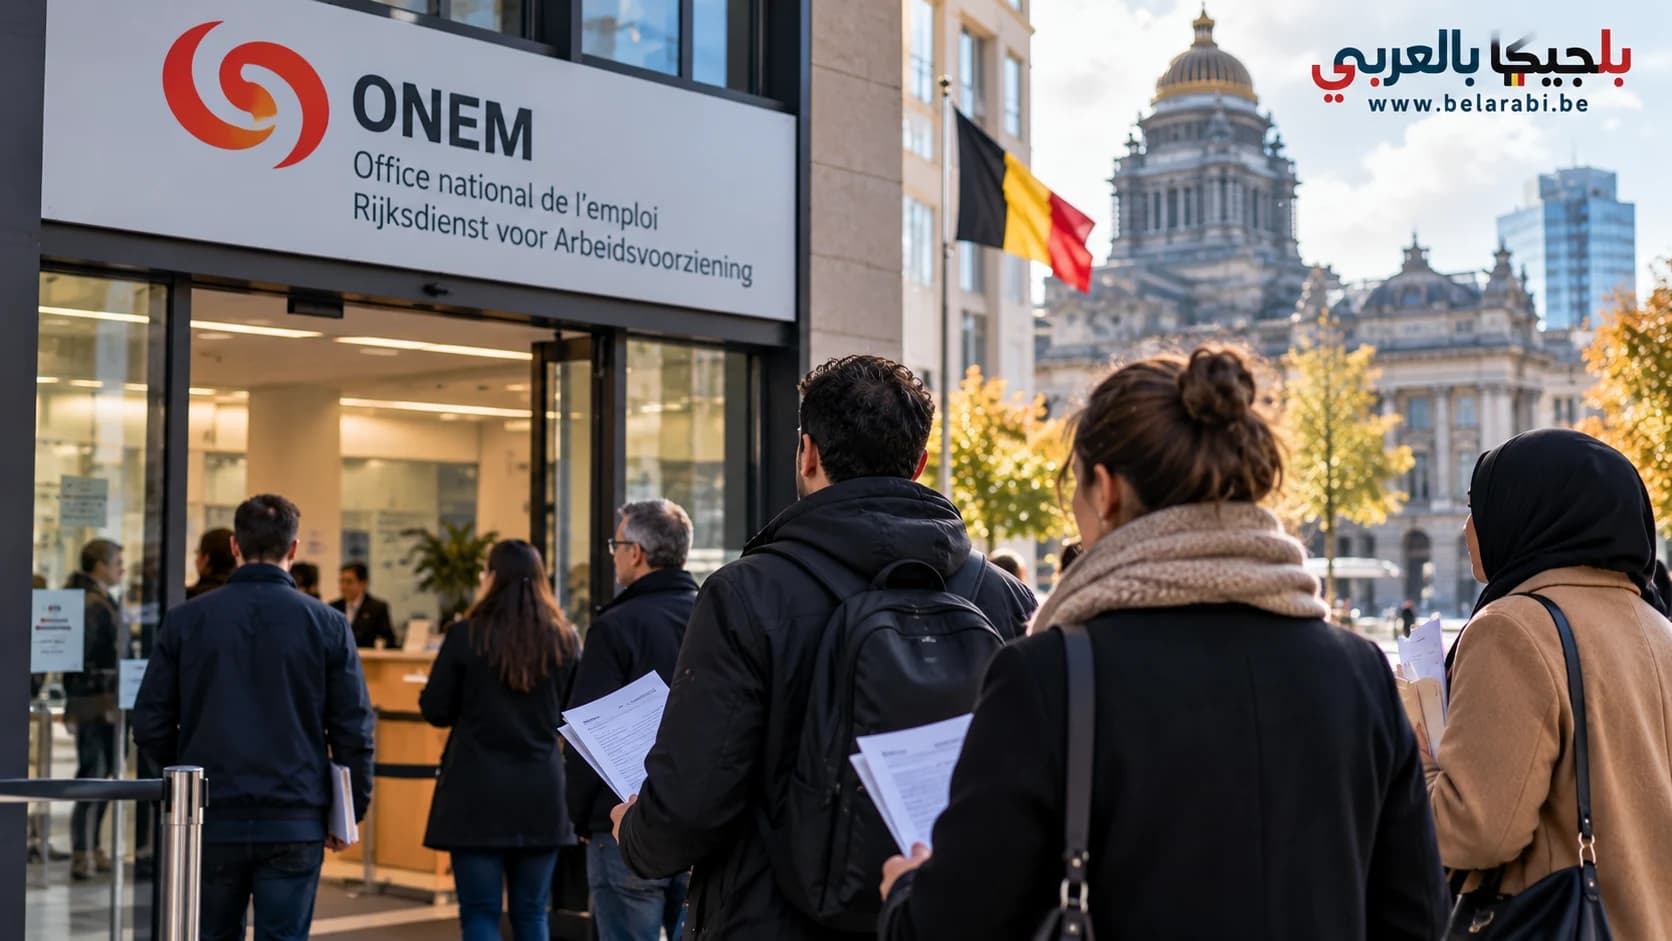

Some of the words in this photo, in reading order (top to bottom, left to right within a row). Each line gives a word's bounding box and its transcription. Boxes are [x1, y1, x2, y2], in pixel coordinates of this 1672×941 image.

[352, 73, 534, 161] ONEM
[353, 150, 430, 190] Office
[439, 167, 534, 209] national
[541, 185, 568, 214] de
[575, 192, 659, 231] l'emploi
[353, 192, 489, 240] Rijksdienst
[497, 222, 548, 249] voor
[554, 226, 754, 288] Arbeidsvoorziening
